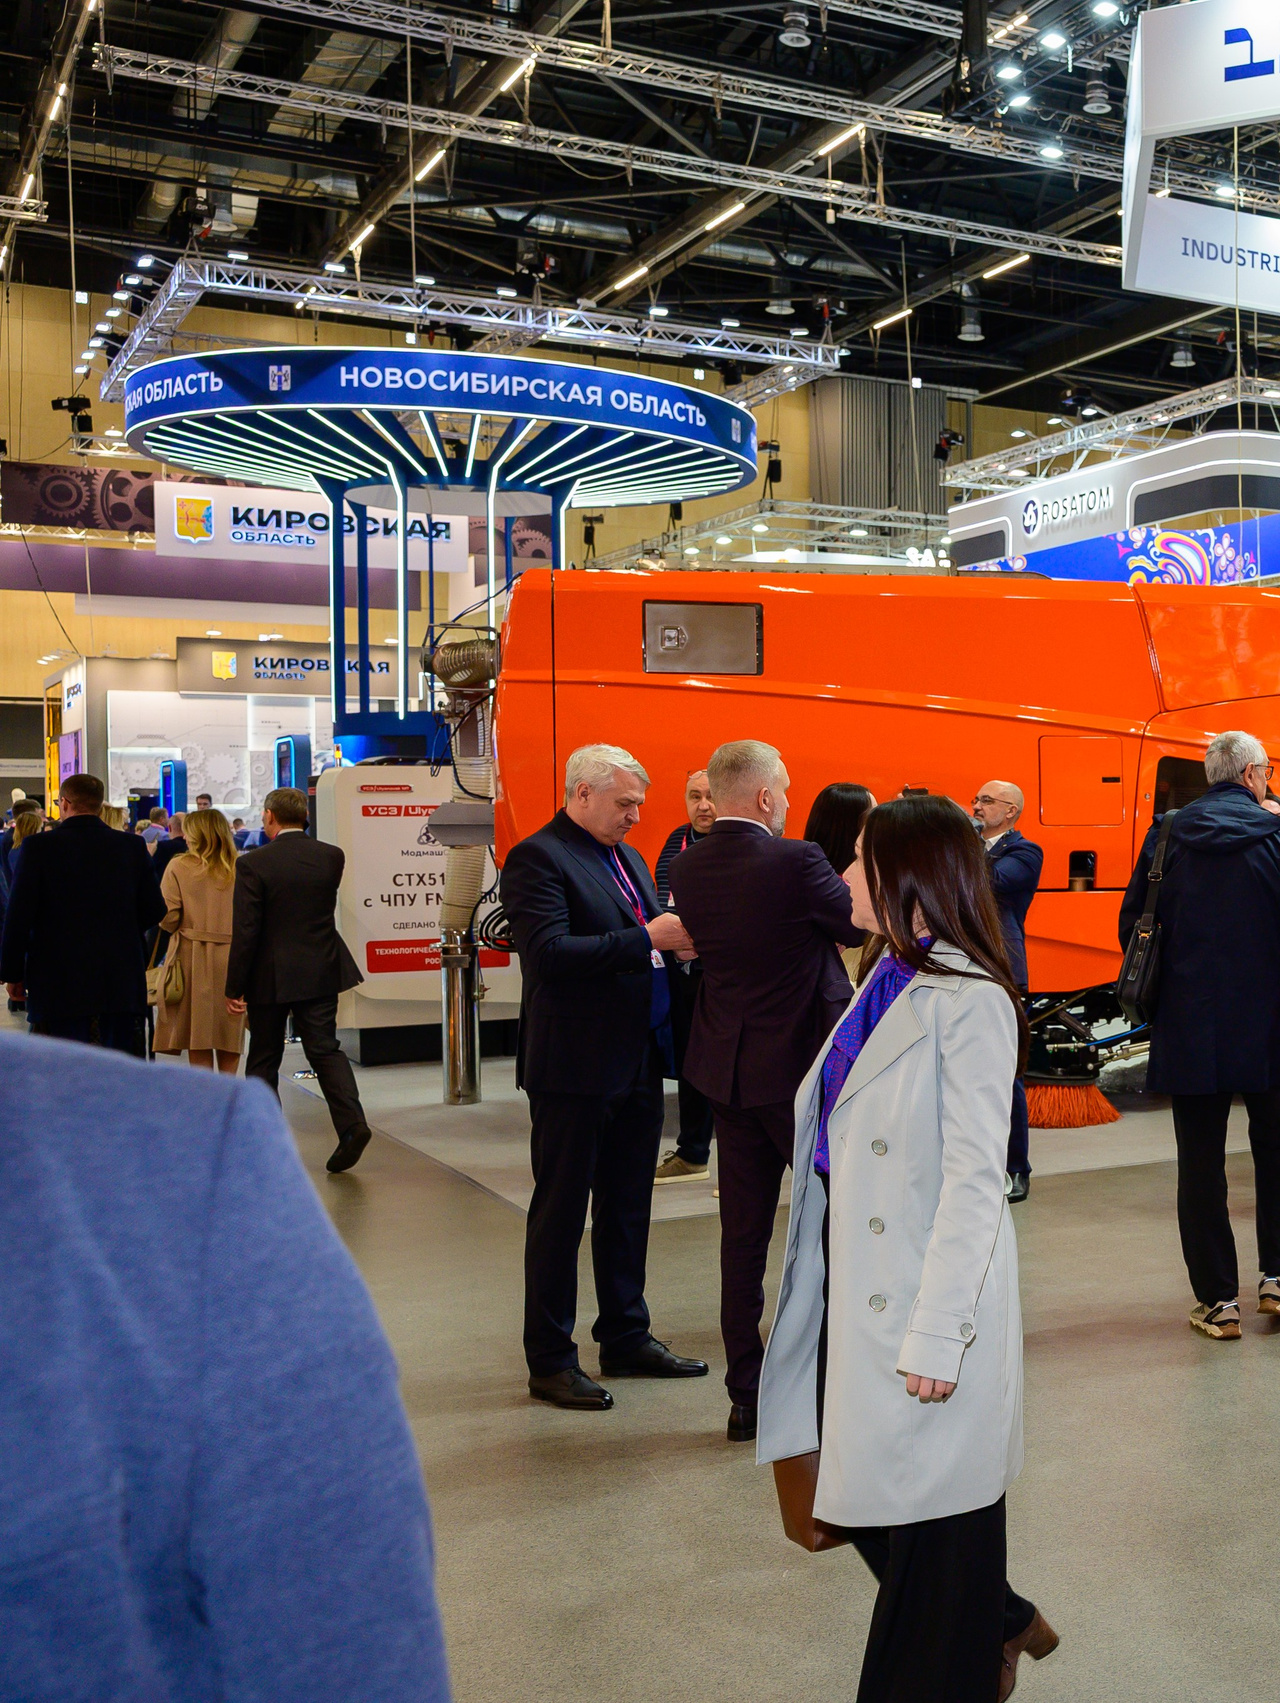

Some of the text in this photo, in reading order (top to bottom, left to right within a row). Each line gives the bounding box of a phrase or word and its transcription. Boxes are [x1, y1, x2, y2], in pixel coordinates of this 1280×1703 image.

[144, 371, 224, 405] ОБЛАСТЬ
[340, 365, 707, 428] НОВОСИБИРСКАЯ ОБЛАСТЬ
[1042, 486, 1111, 523] ROSATOM
[230, 529, 317, 546] ОБЛАСТЬ
[253, 656, 390, 674] КИРОВКЯ
[254, 671, 306, 681] ОБЛАСТЬ
[368, 806, 398, 816] УСЗ
[381, 893, 418, 907] ЧПУ
[392, 921, 436, 930] СДЕЛАНО
